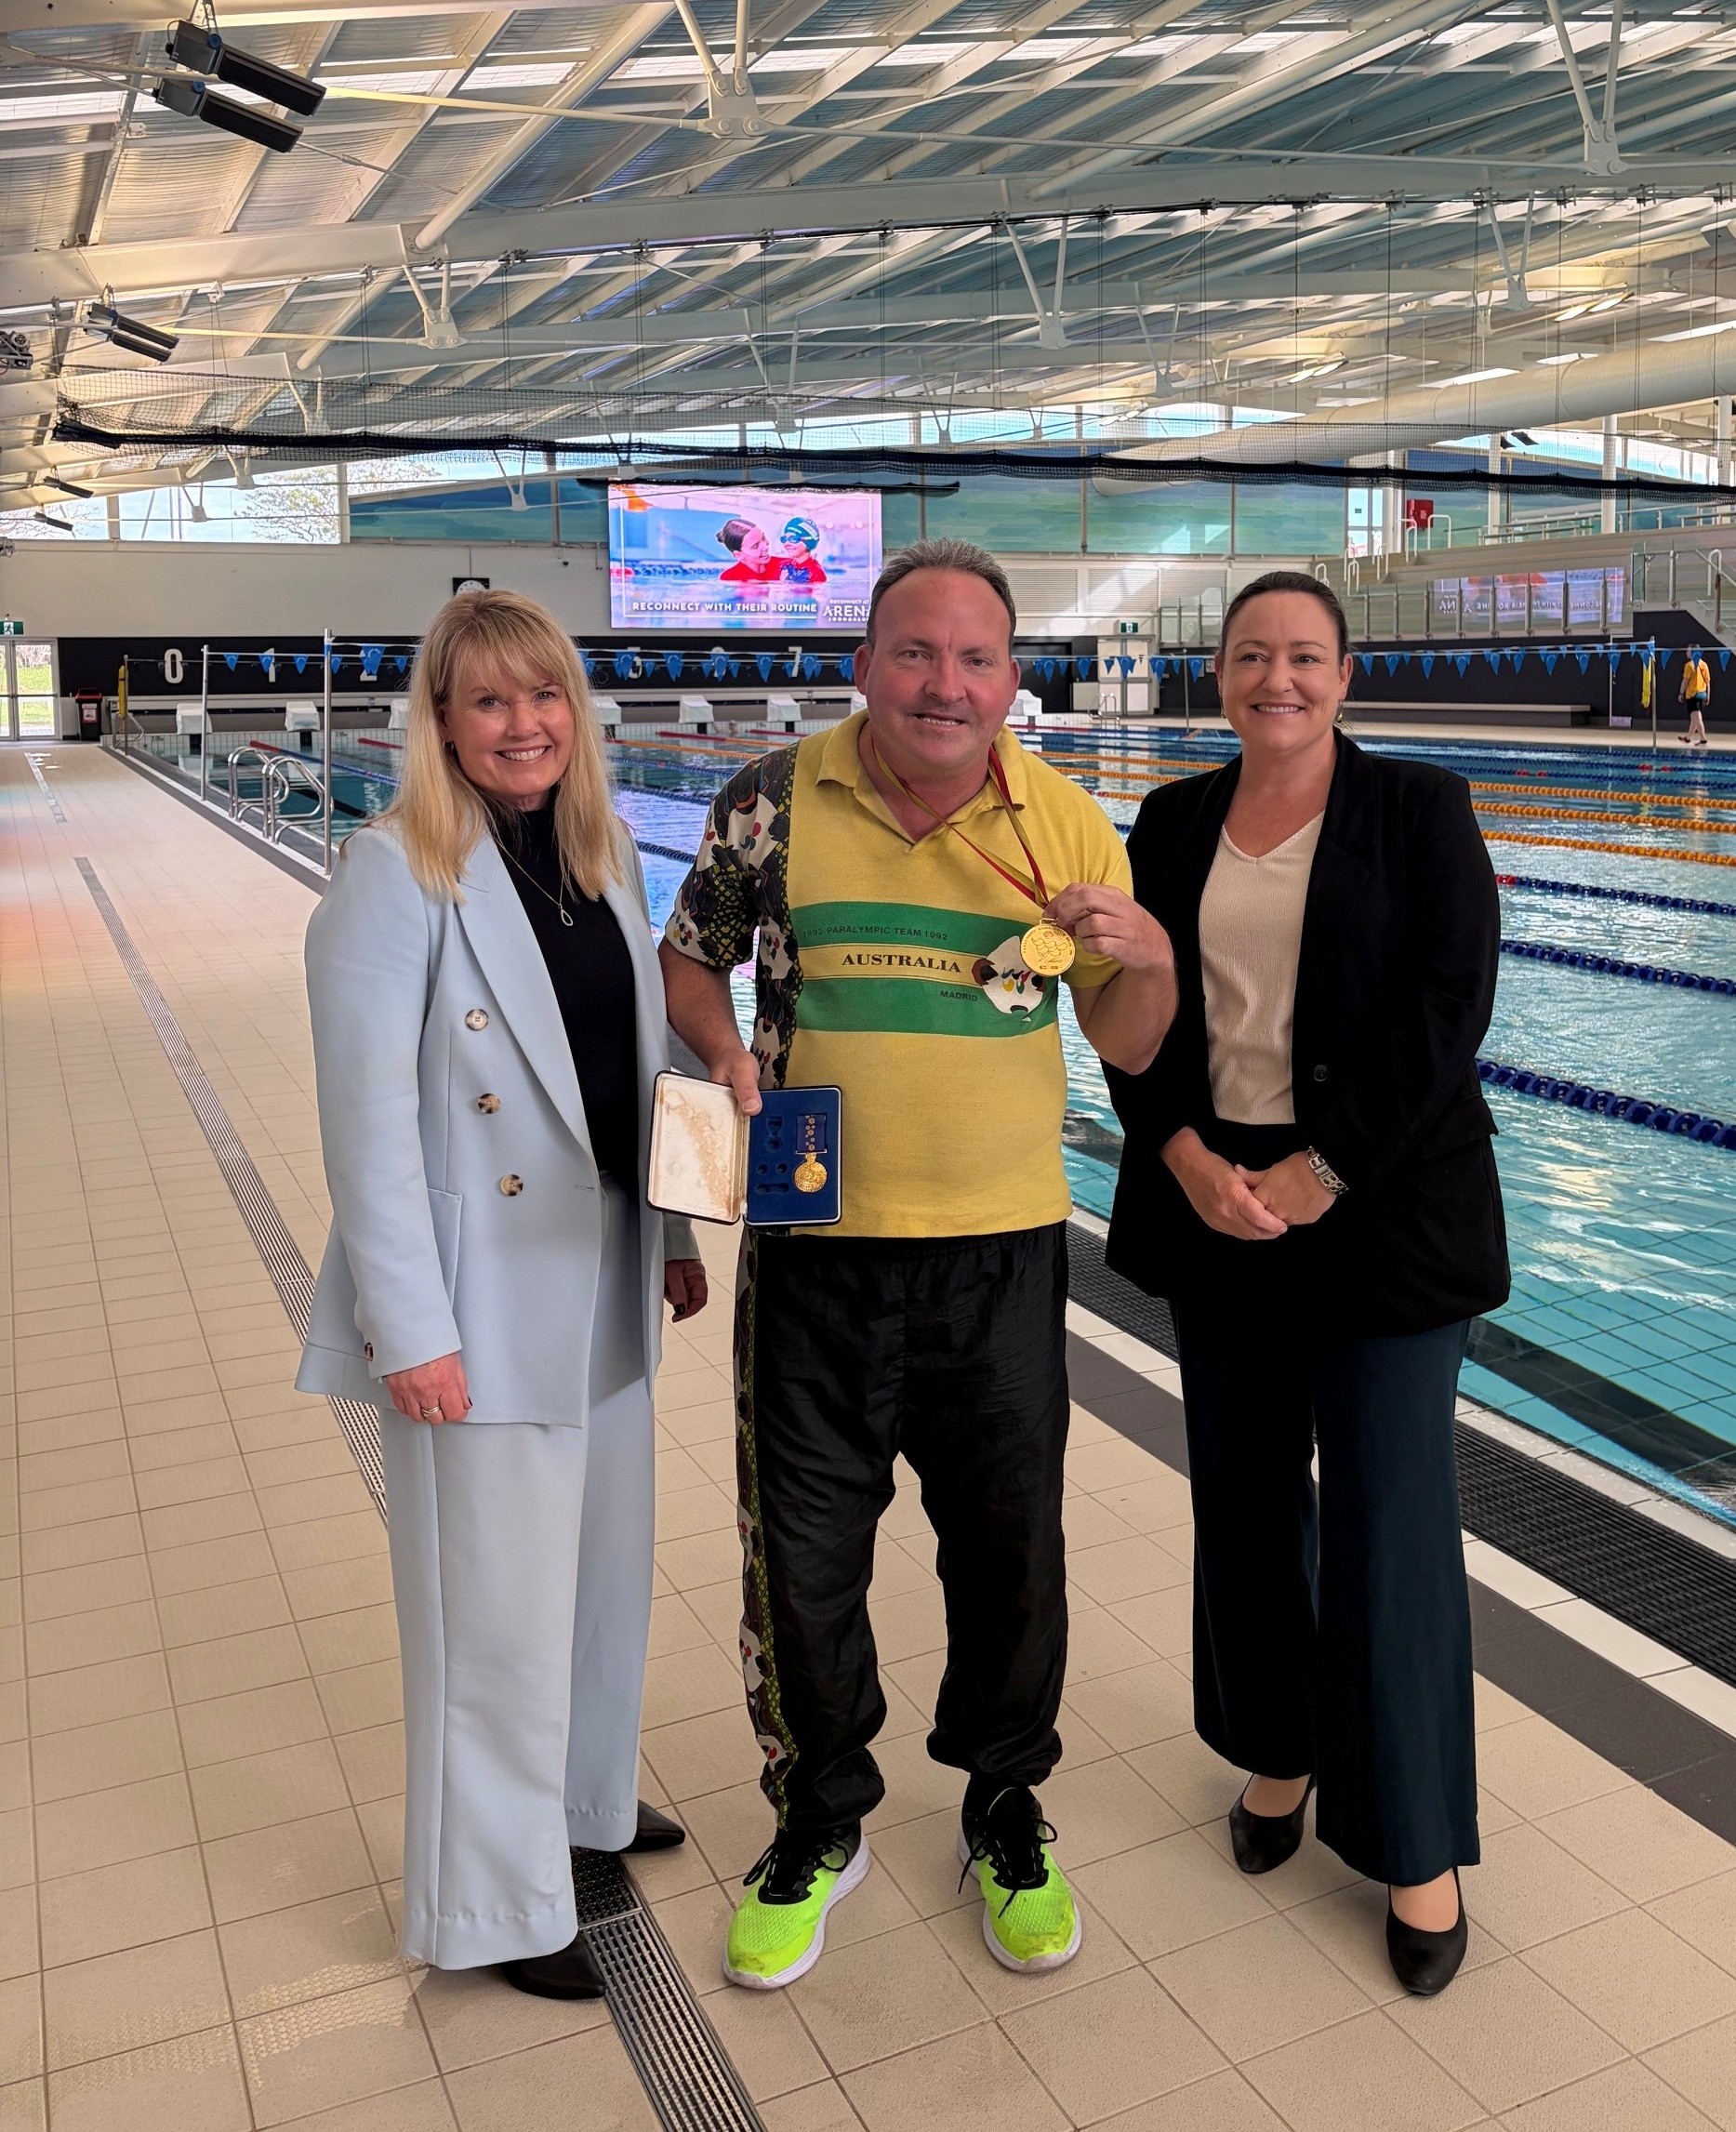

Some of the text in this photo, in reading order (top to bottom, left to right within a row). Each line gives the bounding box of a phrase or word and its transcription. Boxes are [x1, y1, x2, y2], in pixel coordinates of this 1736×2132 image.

[632, 602, 817, 613] RECONNECT WITH THEIR ROUTINE
[165, 648, 183, 683] 0
[263, 647, 275, 682] 1
[788, 646, 802, 678] 7
[802, 926, 948, 941] 1992 PARALYMPIC TEAM 1992
[841, 954, 962, 973] AUSTRALIA
[940, 990, 977, 1001] MADRID
